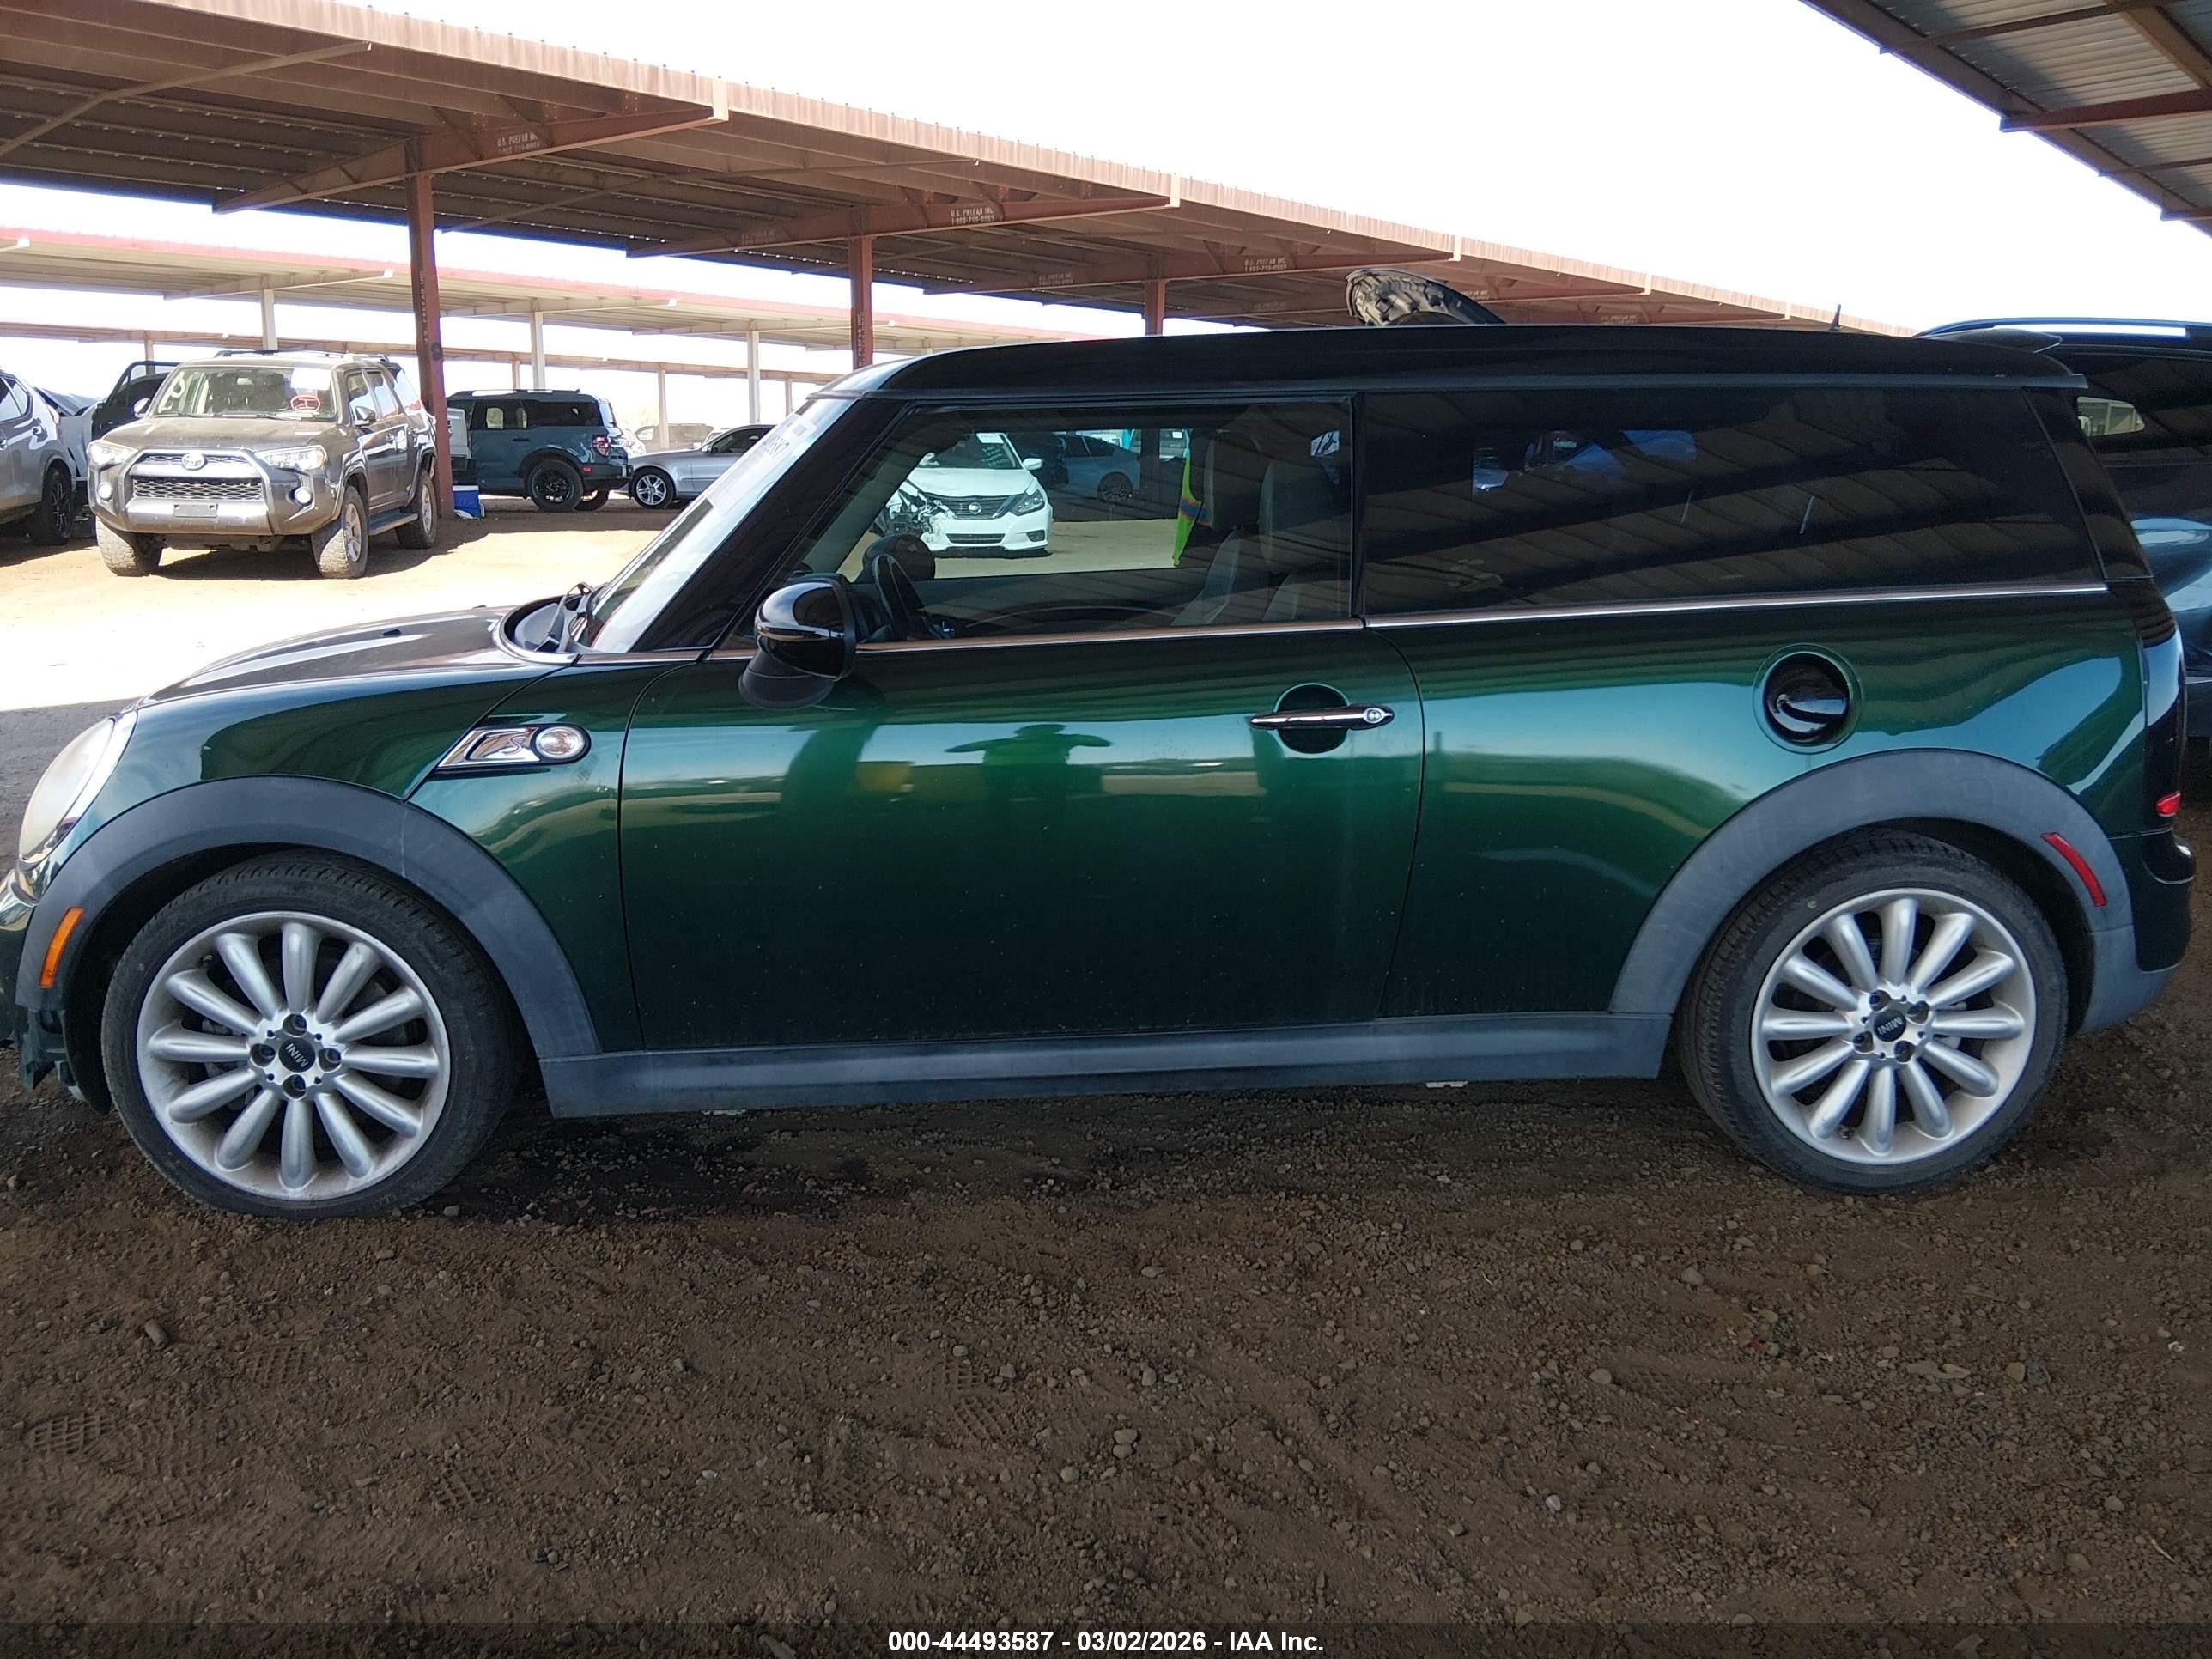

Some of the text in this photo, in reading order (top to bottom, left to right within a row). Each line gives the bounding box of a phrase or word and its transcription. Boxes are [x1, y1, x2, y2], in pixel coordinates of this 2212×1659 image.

[963, 207, 983, 216] PREFAB
[501, 733, 526, 756] S
[1877, 1016, 1904, 1035] MINI
[285, 1042, 309, 1067] MINI
